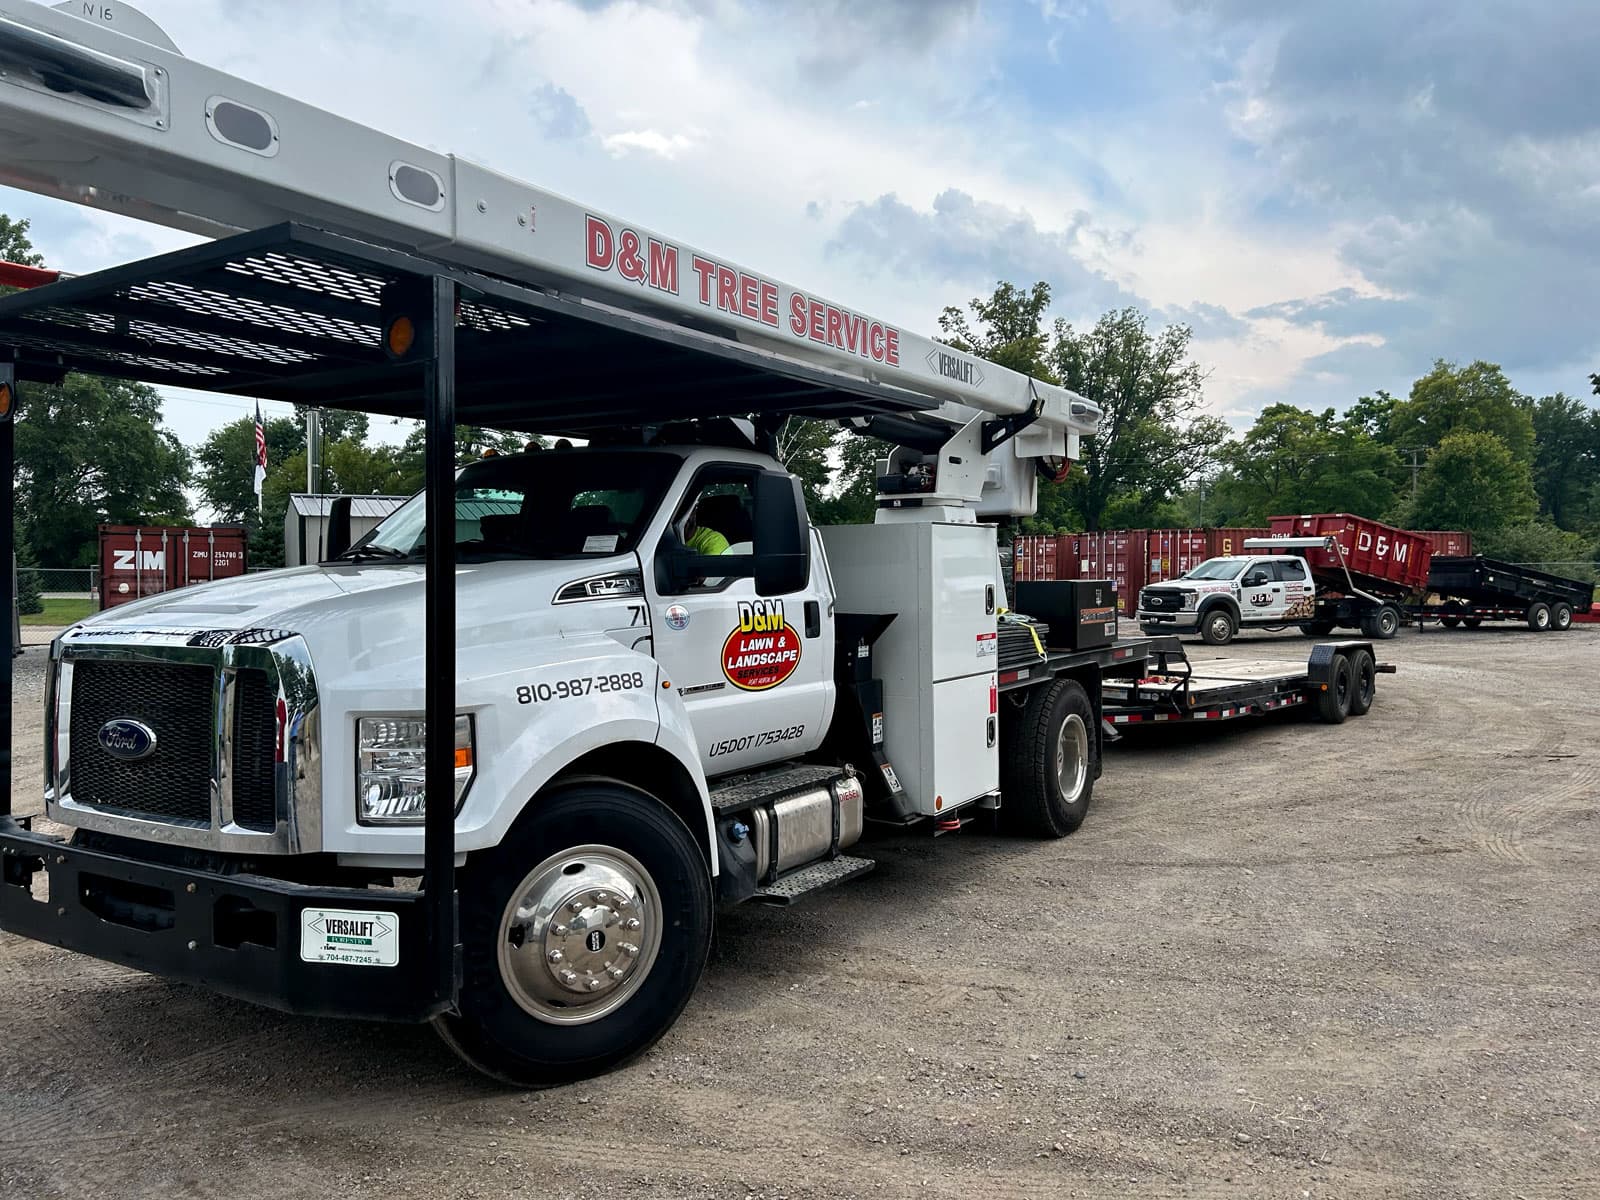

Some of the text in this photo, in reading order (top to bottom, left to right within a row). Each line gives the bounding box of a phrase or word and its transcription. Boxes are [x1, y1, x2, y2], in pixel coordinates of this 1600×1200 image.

[99, 5, 113, 21] 16
[585, 213, 900, 368] D&M TREE SERVICE
[938, 351, 974, 385] VERSALIFT
[113, 550, 165, 570] ZIM
[737, 598, 785, 634] D&M
[740, 636, 786, 652] LAWN &
[727, 649, 798, 670] LANDSCAPE
[737, 665, 779, 679] SERVICES
[516, 671, 644, 704] 810-987-2888
[104, 725, 137, 750] Ford
[709, 724, 805, 757] USDOT 1753428
[838, 790, 860, 802] DIESEL
[325, 919, 374, 937] VERSALIFT
[326, 953, 372, 964] 704-487-7245
